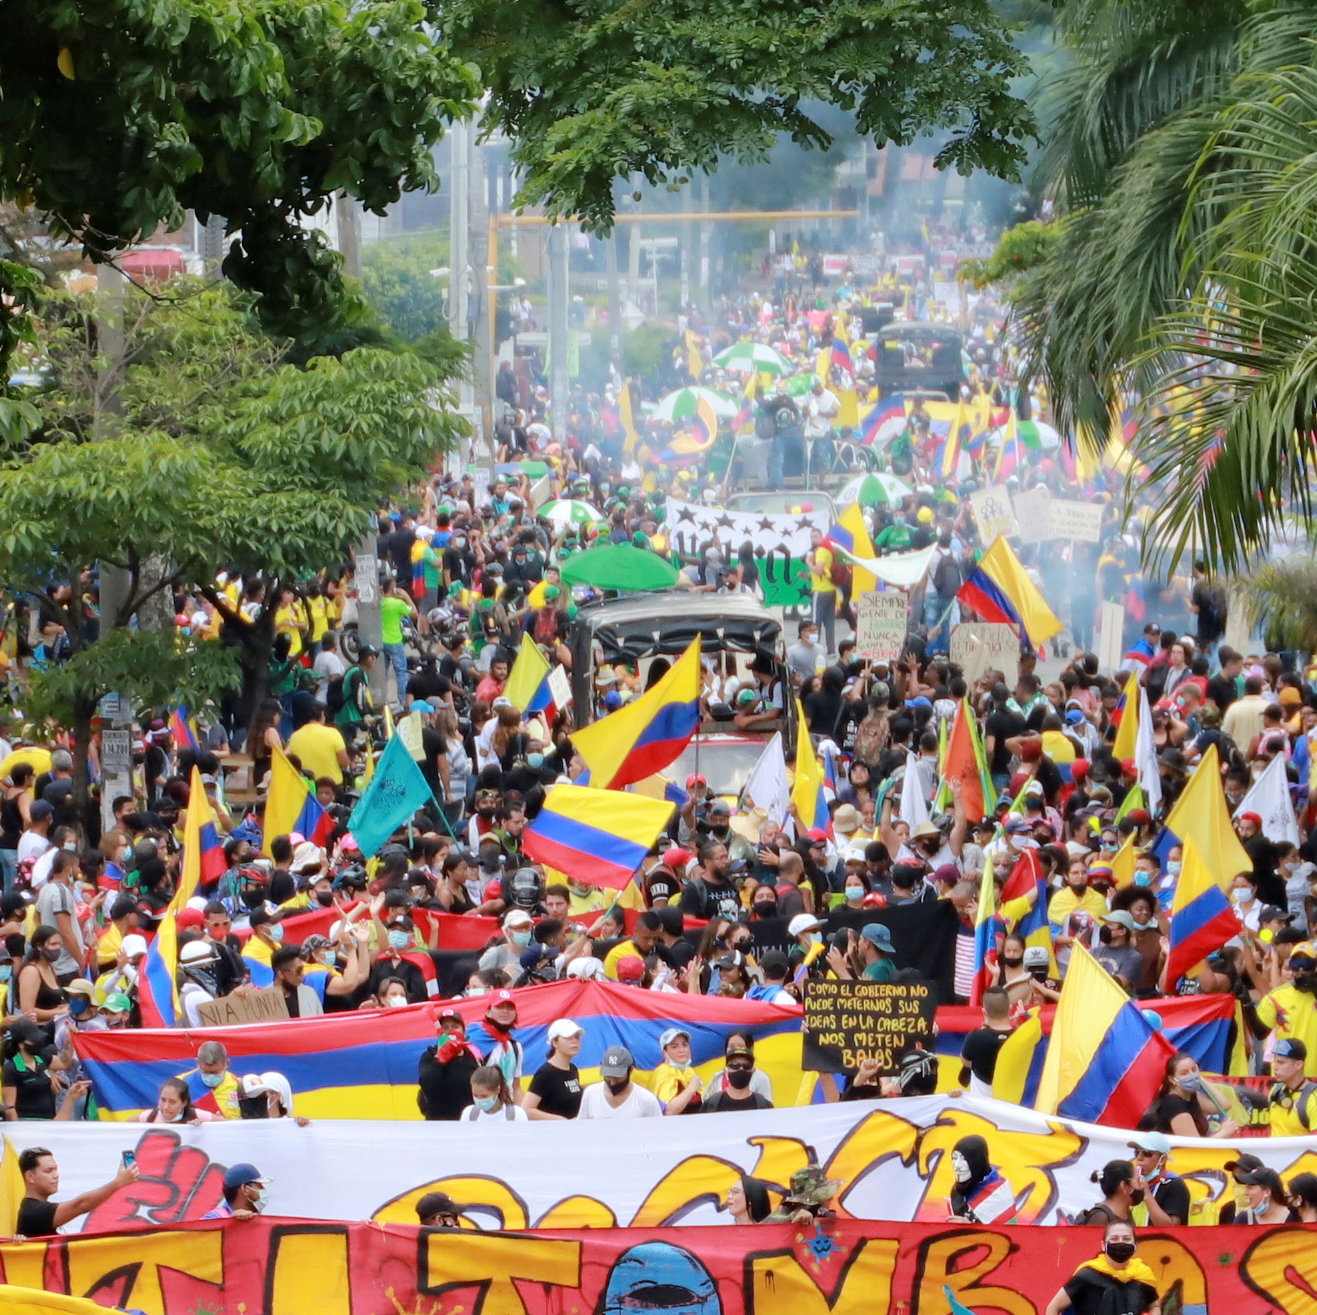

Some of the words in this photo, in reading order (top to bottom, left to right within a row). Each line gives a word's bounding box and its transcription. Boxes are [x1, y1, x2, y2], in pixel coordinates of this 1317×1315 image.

[864, 631, 900, 640] NUNCA
[808, 983, 837, 996] COMO
[841, 985, 852, 996] EL
[855, 984, 906, 997] GOBIERNO
[910, 984, 928, 997] NO
[243, 992, 284, 1020] PUNTA
[805, 997, 834, 1010] PUEDE
[837, 998, 892, 1014] METERNOS
[898, 1000, 920, 1014] SUS
[804, 1014, 836, 1029] IDEAS
[842, 1015, 857, 1028] EN
[859, 1014, 875, 1030] LA
[877, 1017, 929, 1035] CABEZA,
[819, 1033, 845, 1046] NOS
[854, 1033, 905, 1048] METEN
